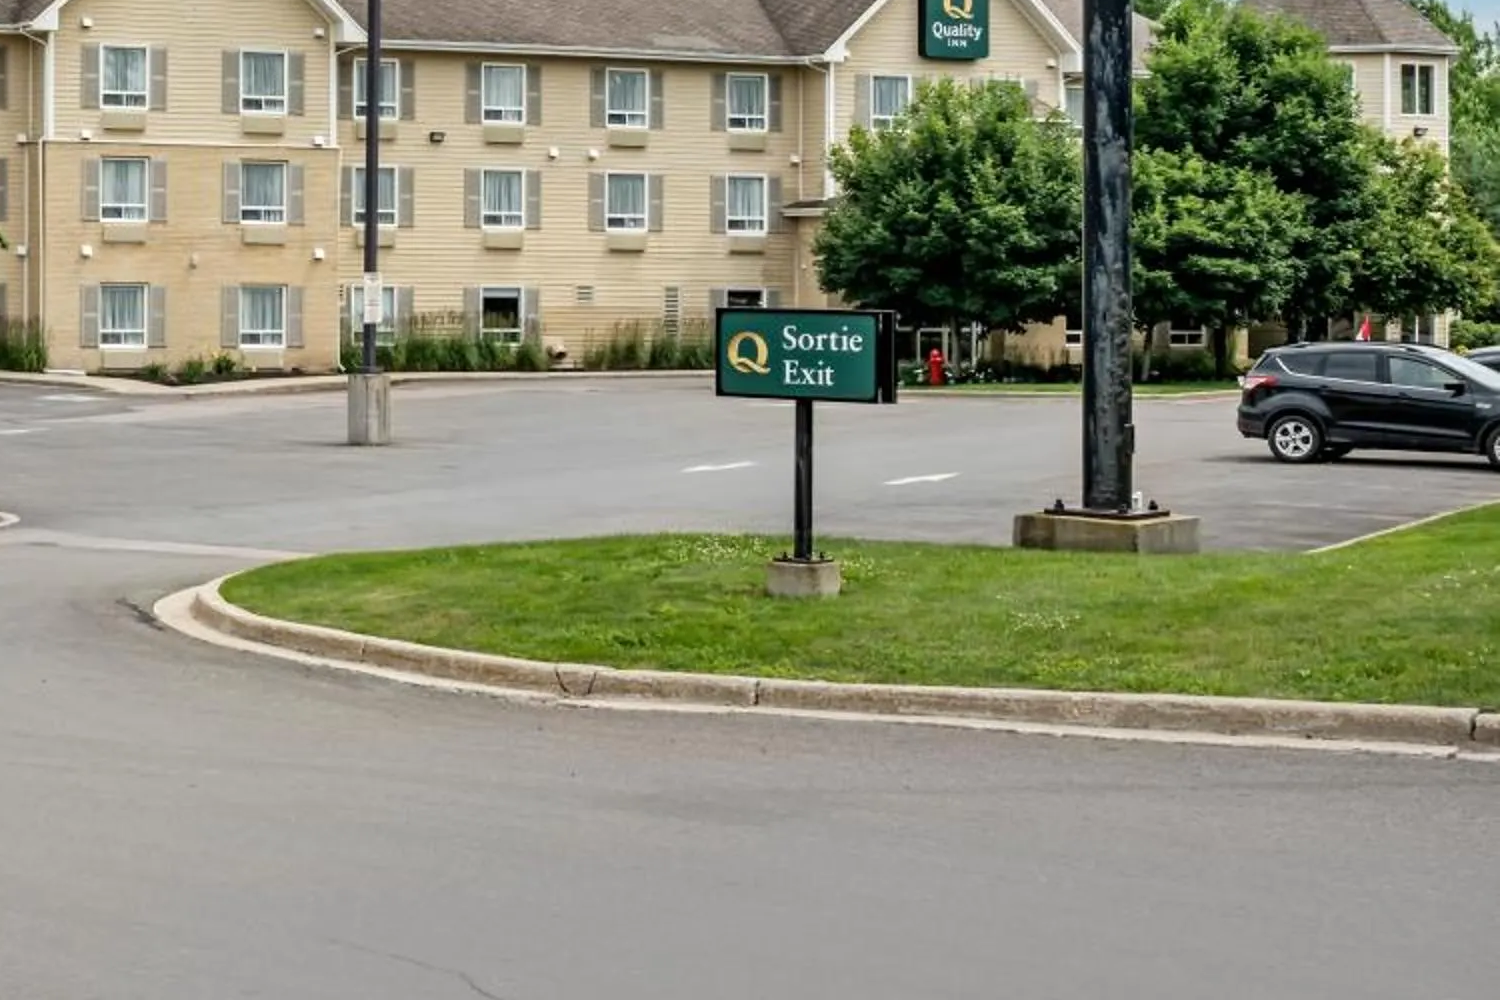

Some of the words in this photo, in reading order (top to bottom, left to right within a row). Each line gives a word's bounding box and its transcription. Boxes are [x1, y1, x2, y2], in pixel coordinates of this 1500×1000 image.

[932, 21, 983, 41] Quality
[782, 325, 863, 352] Sortie
[783, 359, 835, 386] Exit
